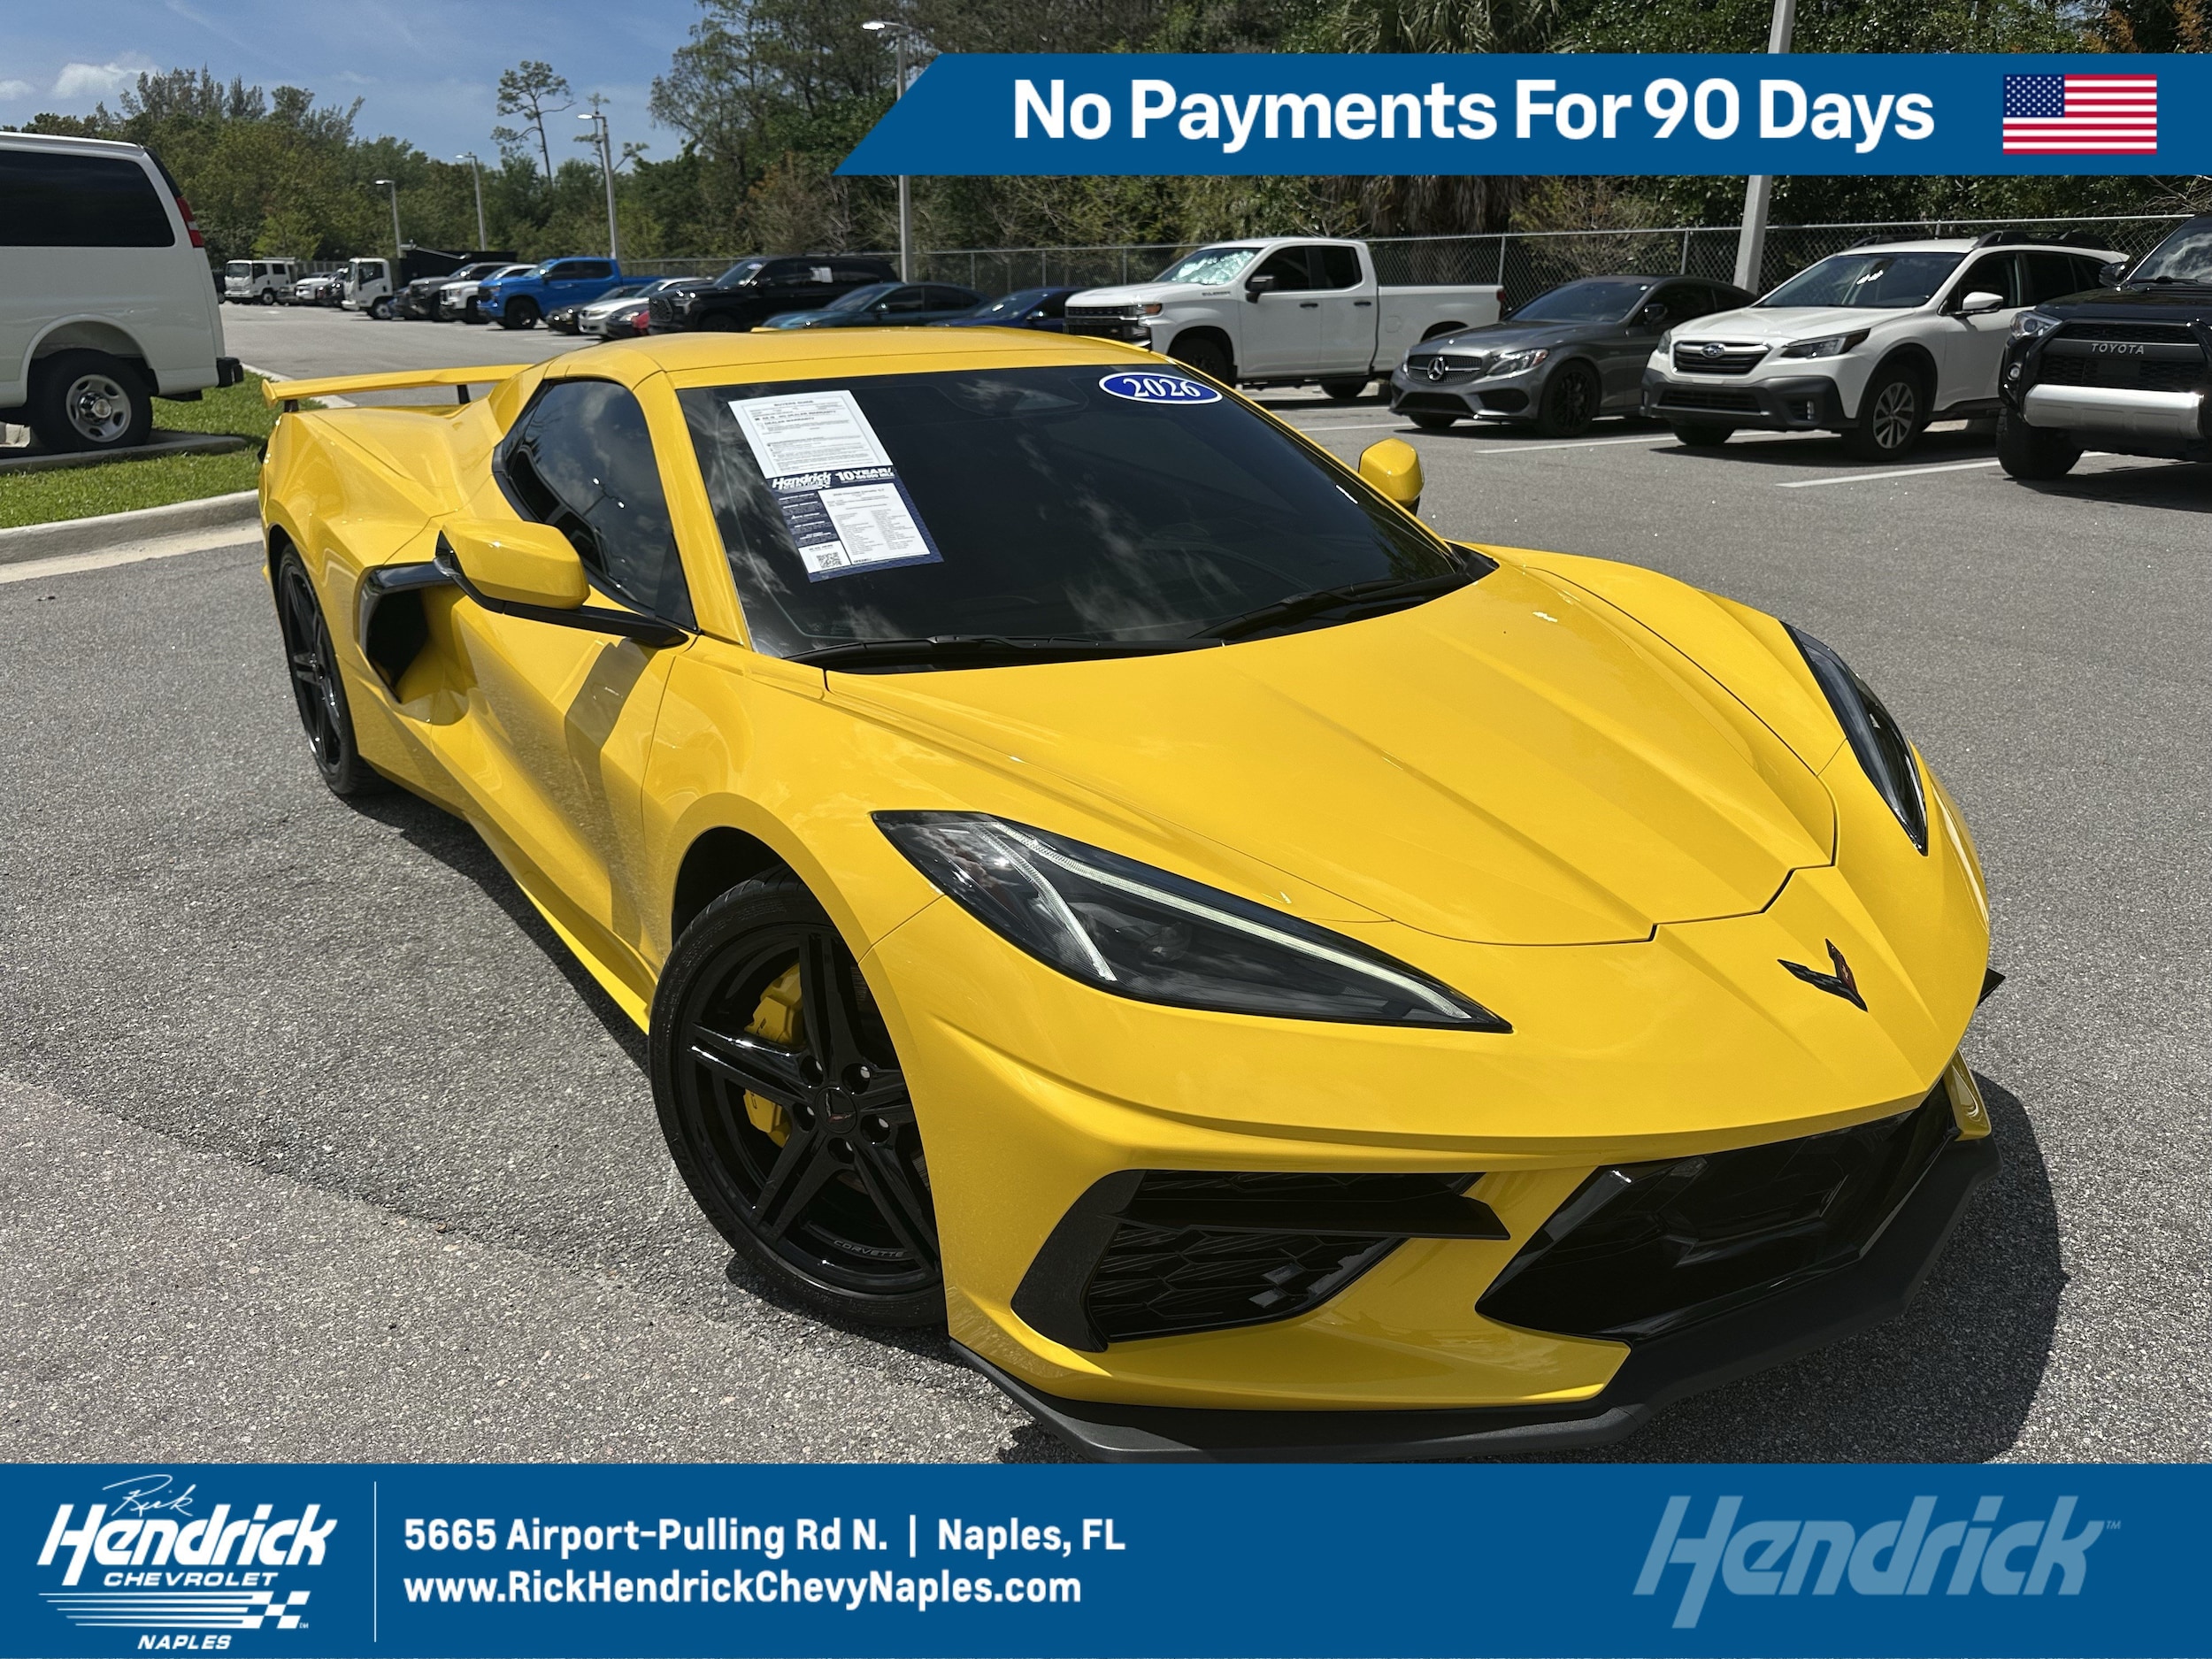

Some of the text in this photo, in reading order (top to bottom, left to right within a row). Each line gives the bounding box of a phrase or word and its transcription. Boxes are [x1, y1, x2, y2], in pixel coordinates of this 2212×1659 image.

[2091, 343, 2145, 355] TOYOTA
[1123, 377, 1202, 397] 2026
[835, 471, 855, 481] 10
[833, 1240, 904, 1257] CORVETTE
